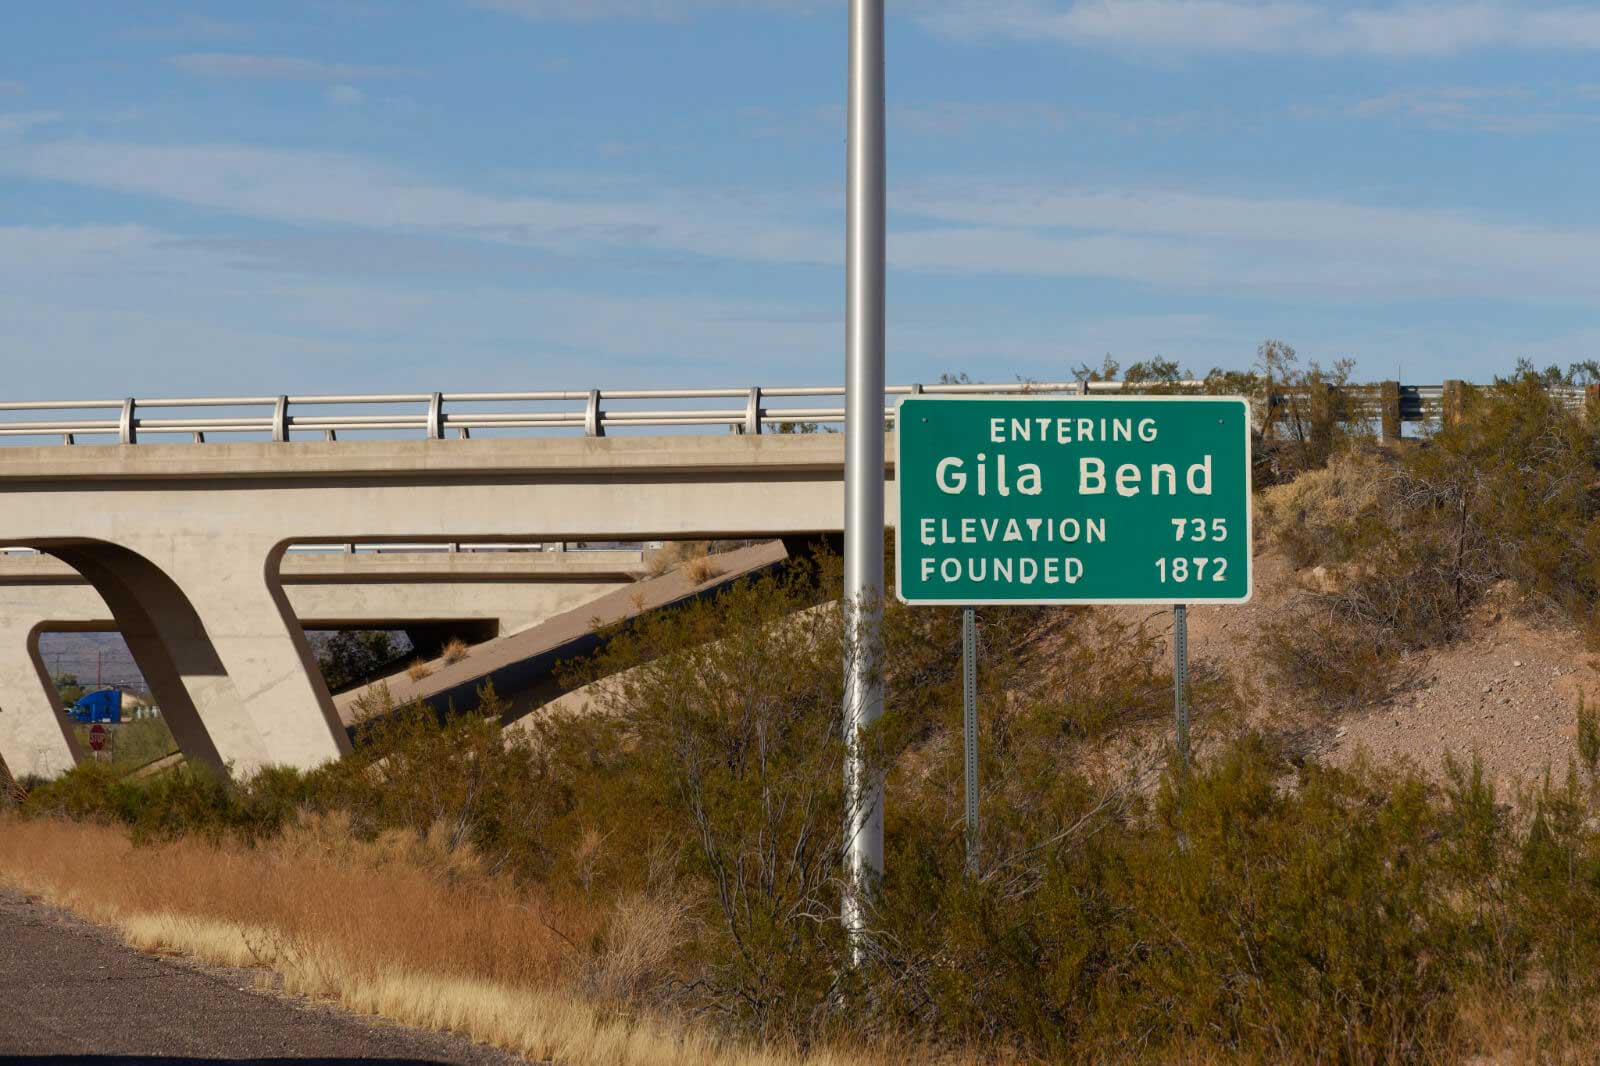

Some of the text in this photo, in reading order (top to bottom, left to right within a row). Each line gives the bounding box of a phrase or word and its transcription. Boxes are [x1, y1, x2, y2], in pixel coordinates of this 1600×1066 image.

[990, 418, 1158, 443] ENTERING
[935, 453, 1212, 496] Gila Bend
[920, 518, 1227, 545] ELEVATION 735
[921, 557, 1228, 583] FOUNDED 1872
